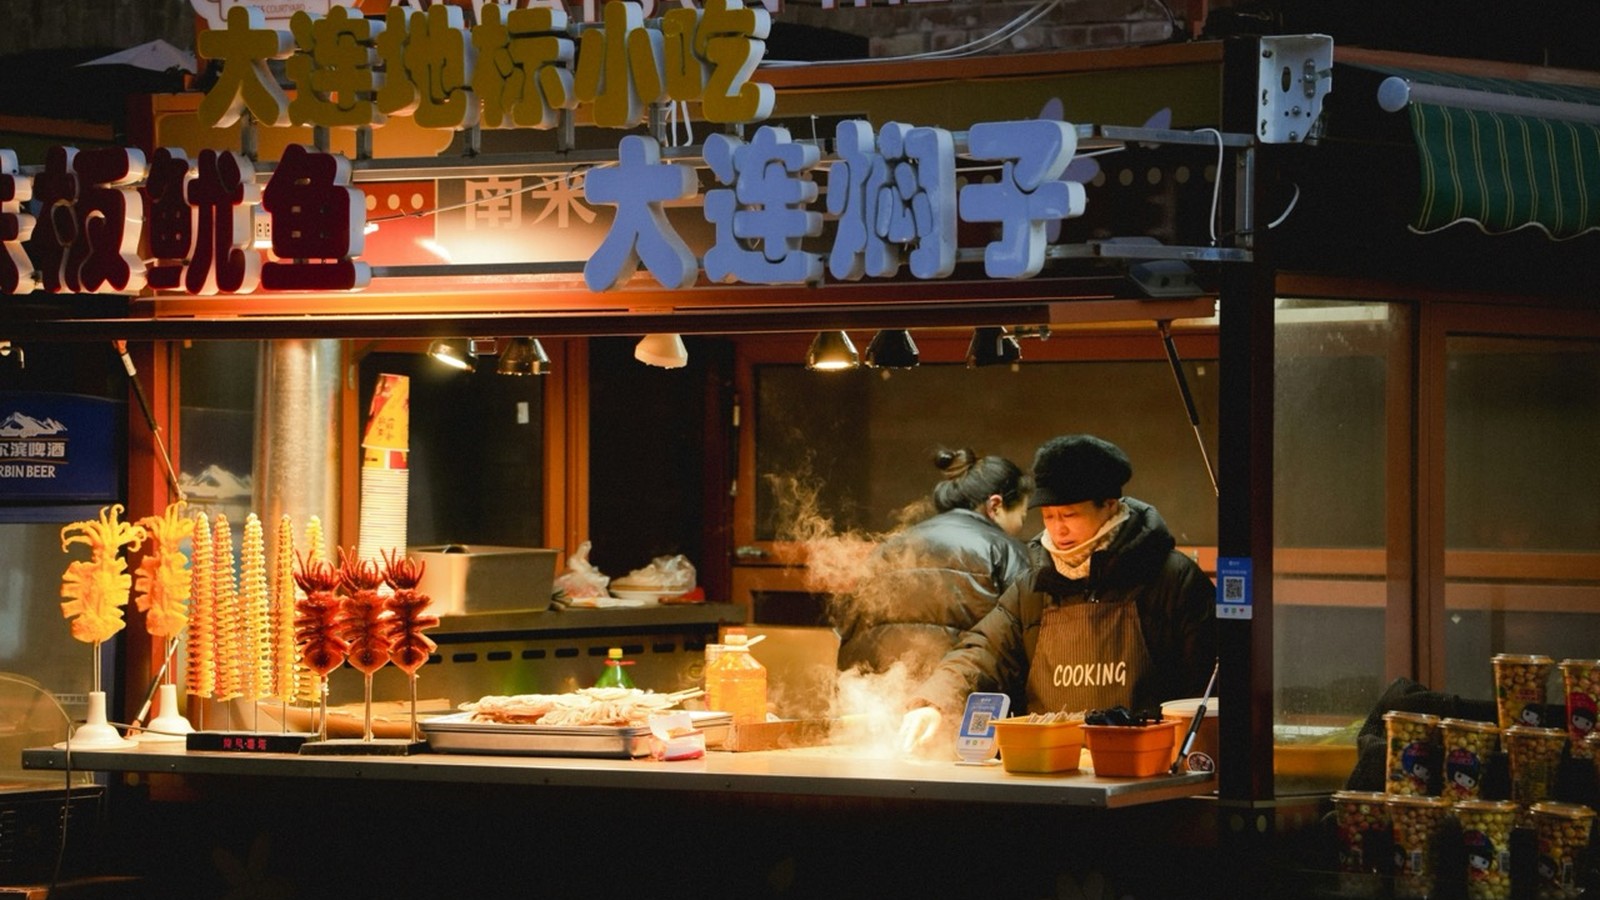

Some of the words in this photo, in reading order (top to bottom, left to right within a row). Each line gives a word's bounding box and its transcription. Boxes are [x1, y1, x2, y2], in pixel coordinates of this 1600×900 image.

[197, 0, 776, 128] 大连地标小吃
[583, 120, 1086, 292] 大连焖子
[26, 465, 57, 478] BEER
[1053, 661, 1126, 687] COOKING
